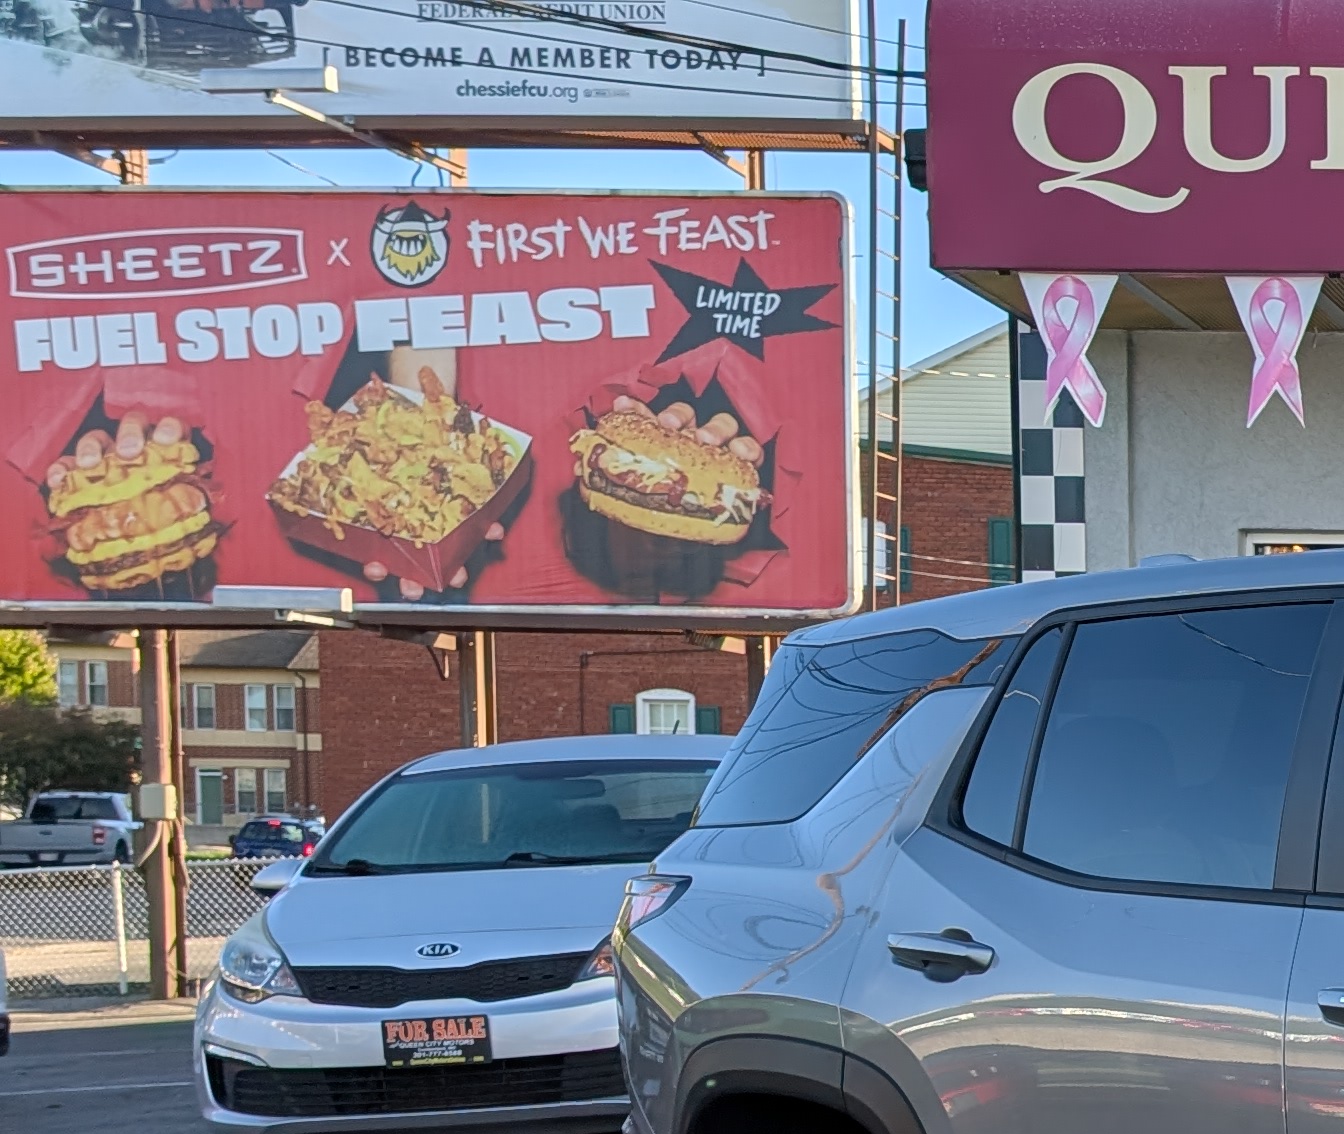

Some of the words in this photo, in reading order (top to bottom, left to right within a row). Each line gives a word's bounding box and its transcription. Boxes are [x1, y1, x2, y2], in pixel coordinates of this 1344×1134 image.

[600, 4, 665, 21] UNION
[346, 46, 463, 68] BECOME
[477, 46, 496, 68] A
[510, 46, 632, 69] MEMBER
[645, 48, 743, 70] TODAY
[456, 79, 579, 103] chessiefcu.org
[467, 219, 566, 269] FIRST
[577, 221, 639, 260] WE
[642, 208, 775, 254] FEAST
[29, 241, 291, 282] SHEETZ
[695, 285, 782, 317] LIMITED
[14, 311, 168, 372] FUEL
[175, 301, 344, 364] STOP
[354, 284, 656, 353] FEAST
[713, 312, 763, 339] TIME
[422, 944, 453, 955] KIA
[432, 1016, 486, 1041] SALE
[425, 1040, 442, 1048] CITY
[443, 1038, 475, 1046] MOTORS
